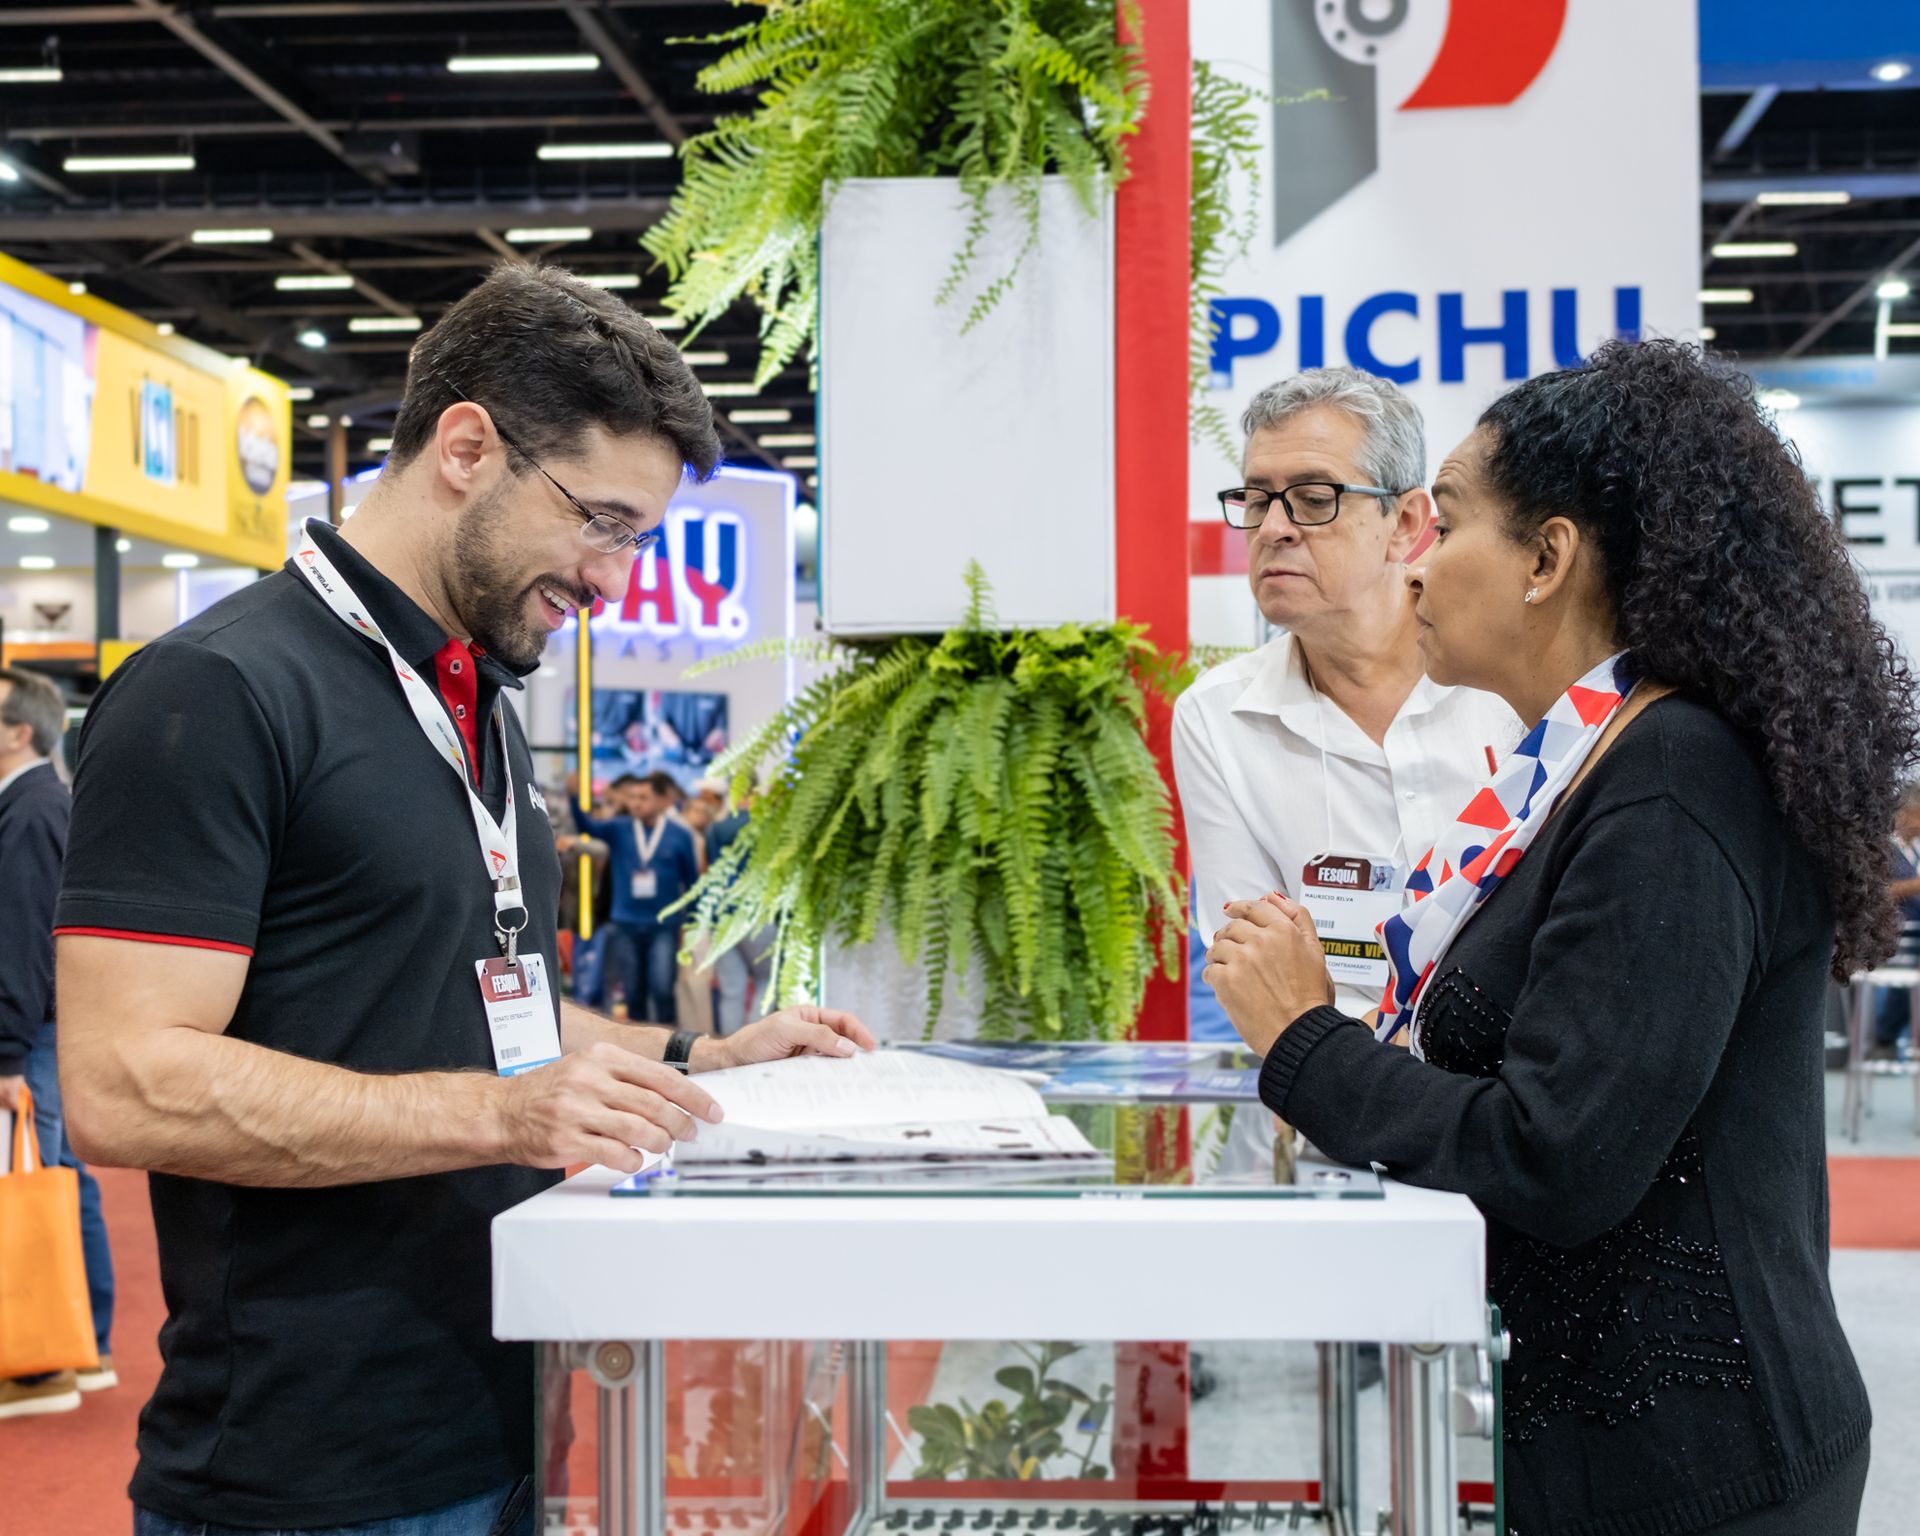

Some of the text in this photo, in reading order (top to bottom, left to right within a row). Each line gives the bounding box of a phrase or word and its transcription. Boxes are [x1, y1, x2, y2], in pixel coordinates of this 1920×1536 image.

[1209, 286, 1642, 386] PICHU
[566, 519, 741, 628] AY.
[1318, 867, 1358, 884] FESQUA
[1320, 941, 1361, 956] SITANTE
[1328, 961, 1372, 970] CONTRAMARCO
[491, 973, 521, 994] FESQUA
